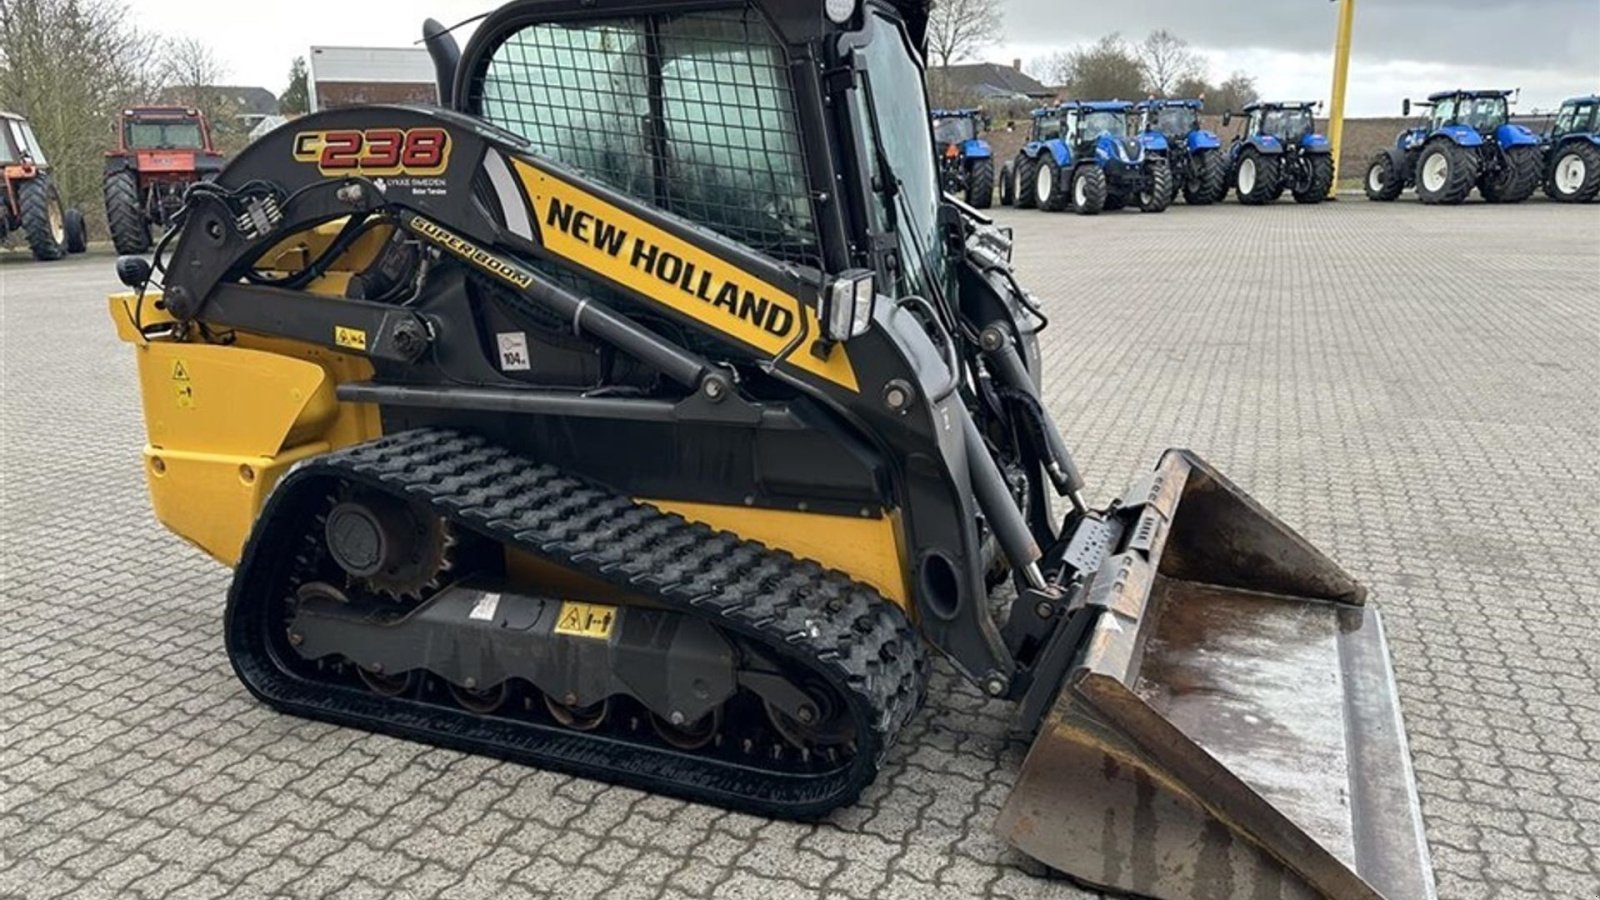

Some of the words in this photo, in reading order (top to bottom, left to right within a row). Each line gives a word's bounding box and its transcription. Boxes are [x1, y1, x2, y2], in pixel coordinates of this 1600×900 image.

[294, 129, 451, 175] C238
[412, 217, 474, 258] SUPER
[473, 249, 532, 288] BOOM
[546, 197, 627, 257] NEW
[629, 238, 794, 338] HOLLAND
[503, 351, 521, 366] 104
